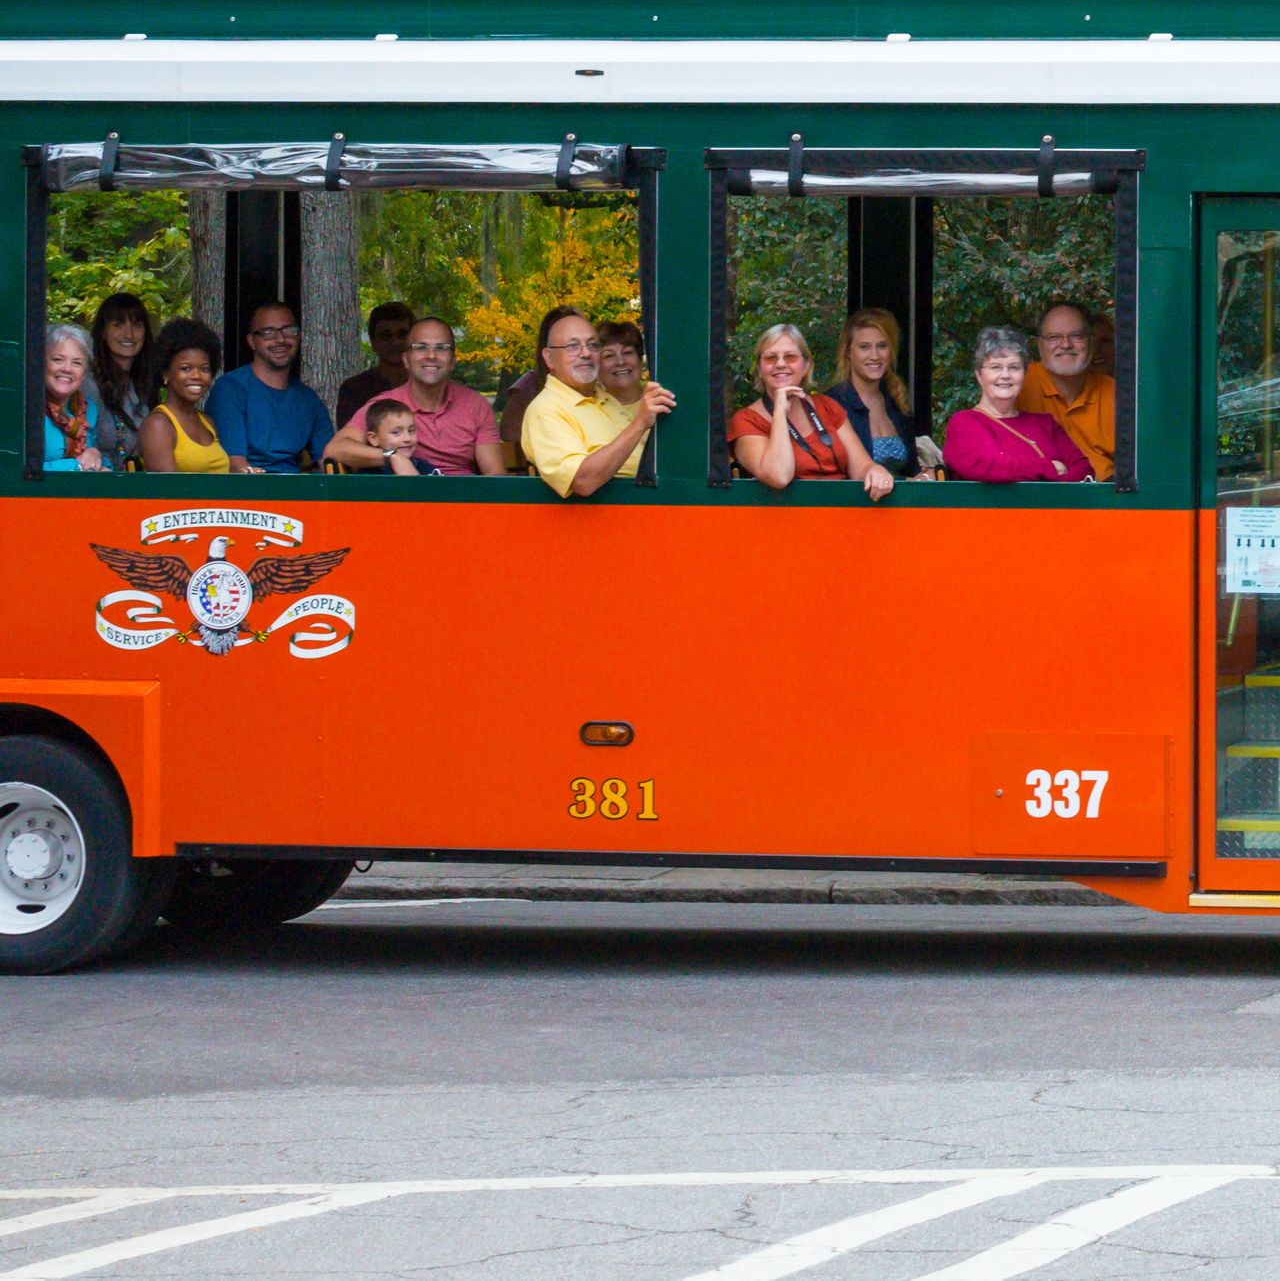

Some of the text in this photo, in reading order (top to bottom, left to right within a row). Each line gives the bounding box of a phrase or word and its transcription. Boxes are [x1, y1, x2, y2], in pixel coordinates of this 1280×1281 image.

[163, 510, 278, 529] ENTERTAINMENT
[293, 598, 345, 616] PEOPLE
[105, 627, 162, 646] SERVICE
[568, 777, 659, 821] 381
[1025, 769, 1109, 819] 337
